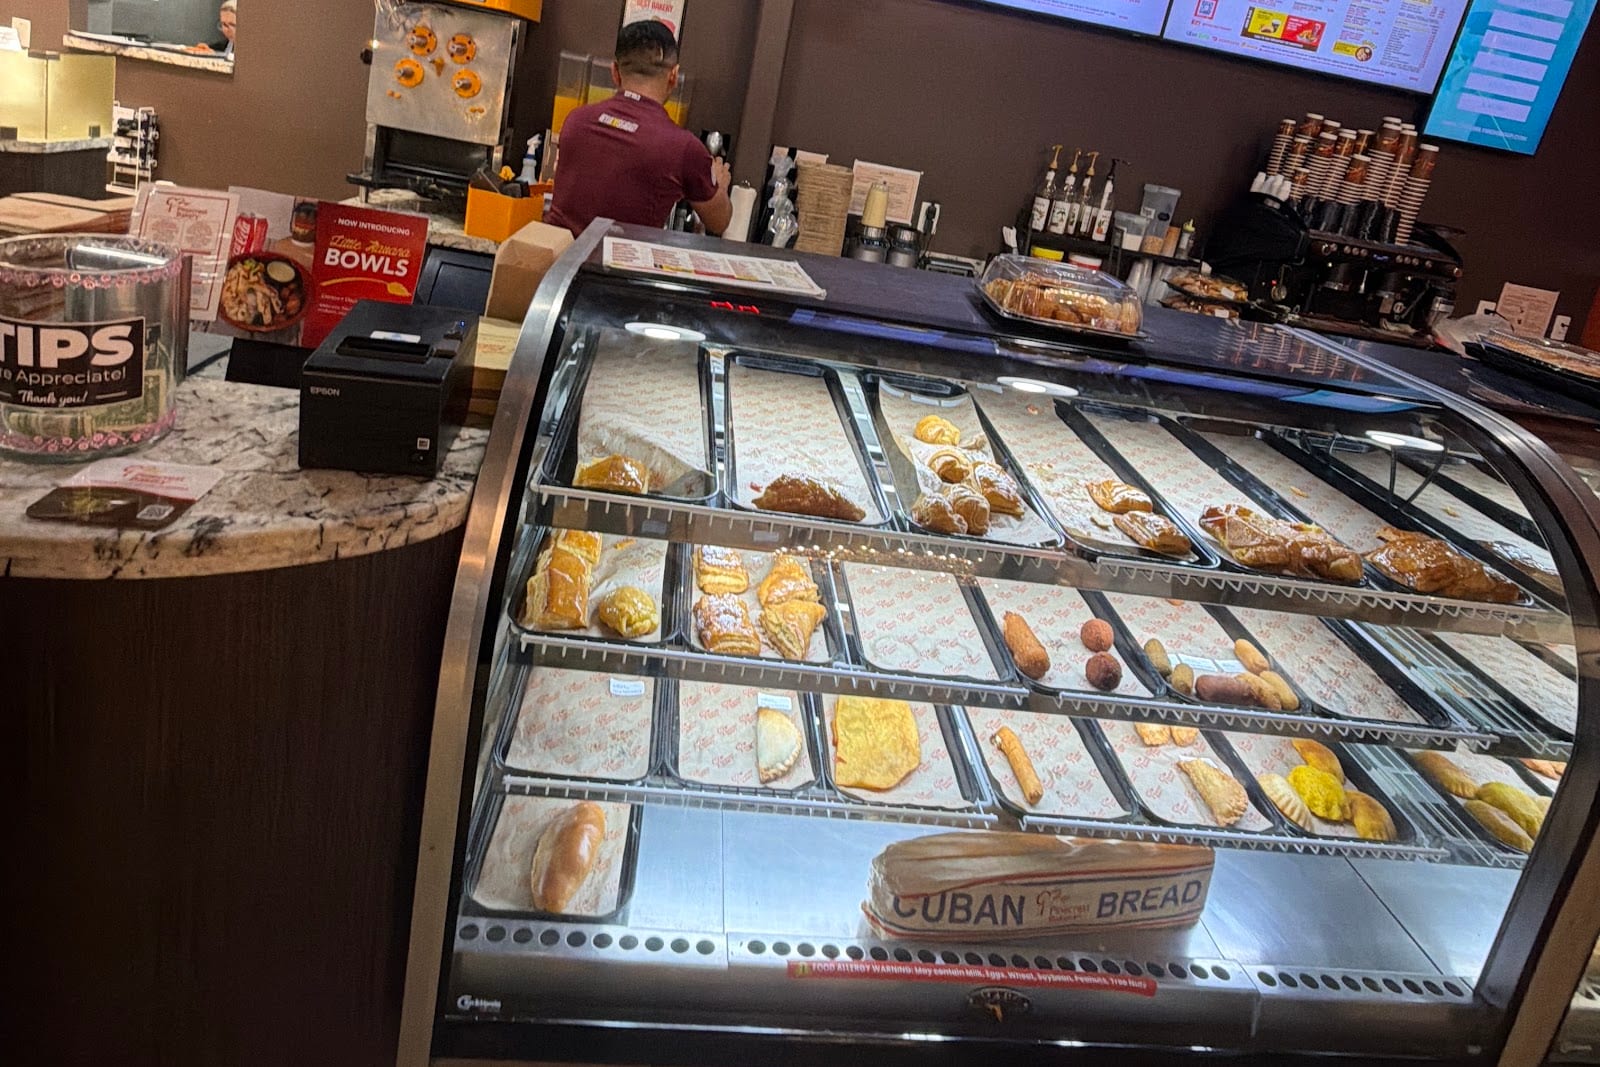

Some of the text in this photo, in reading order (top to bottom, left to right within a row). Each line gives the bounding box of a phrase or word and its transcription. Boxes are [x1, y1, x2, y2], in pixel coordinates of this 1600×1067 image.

[337, 218, 410, 236] NOW INTRODUCING
[324, 247, 410, 277] BOWLS
[16, 365, 127, 387] Appreciate!
[18, 389, 89, 408] Thank you!
[310, 386, 341, 397] EPSON
[893, 890, 1026, 926] CUBAN
[1097, 880, 1202, 919] BREAD
[812, 962, 835, 972] FOOD
[837, 962, 871, 973] ALLERGY
[933, 967, 965, 977] contain
